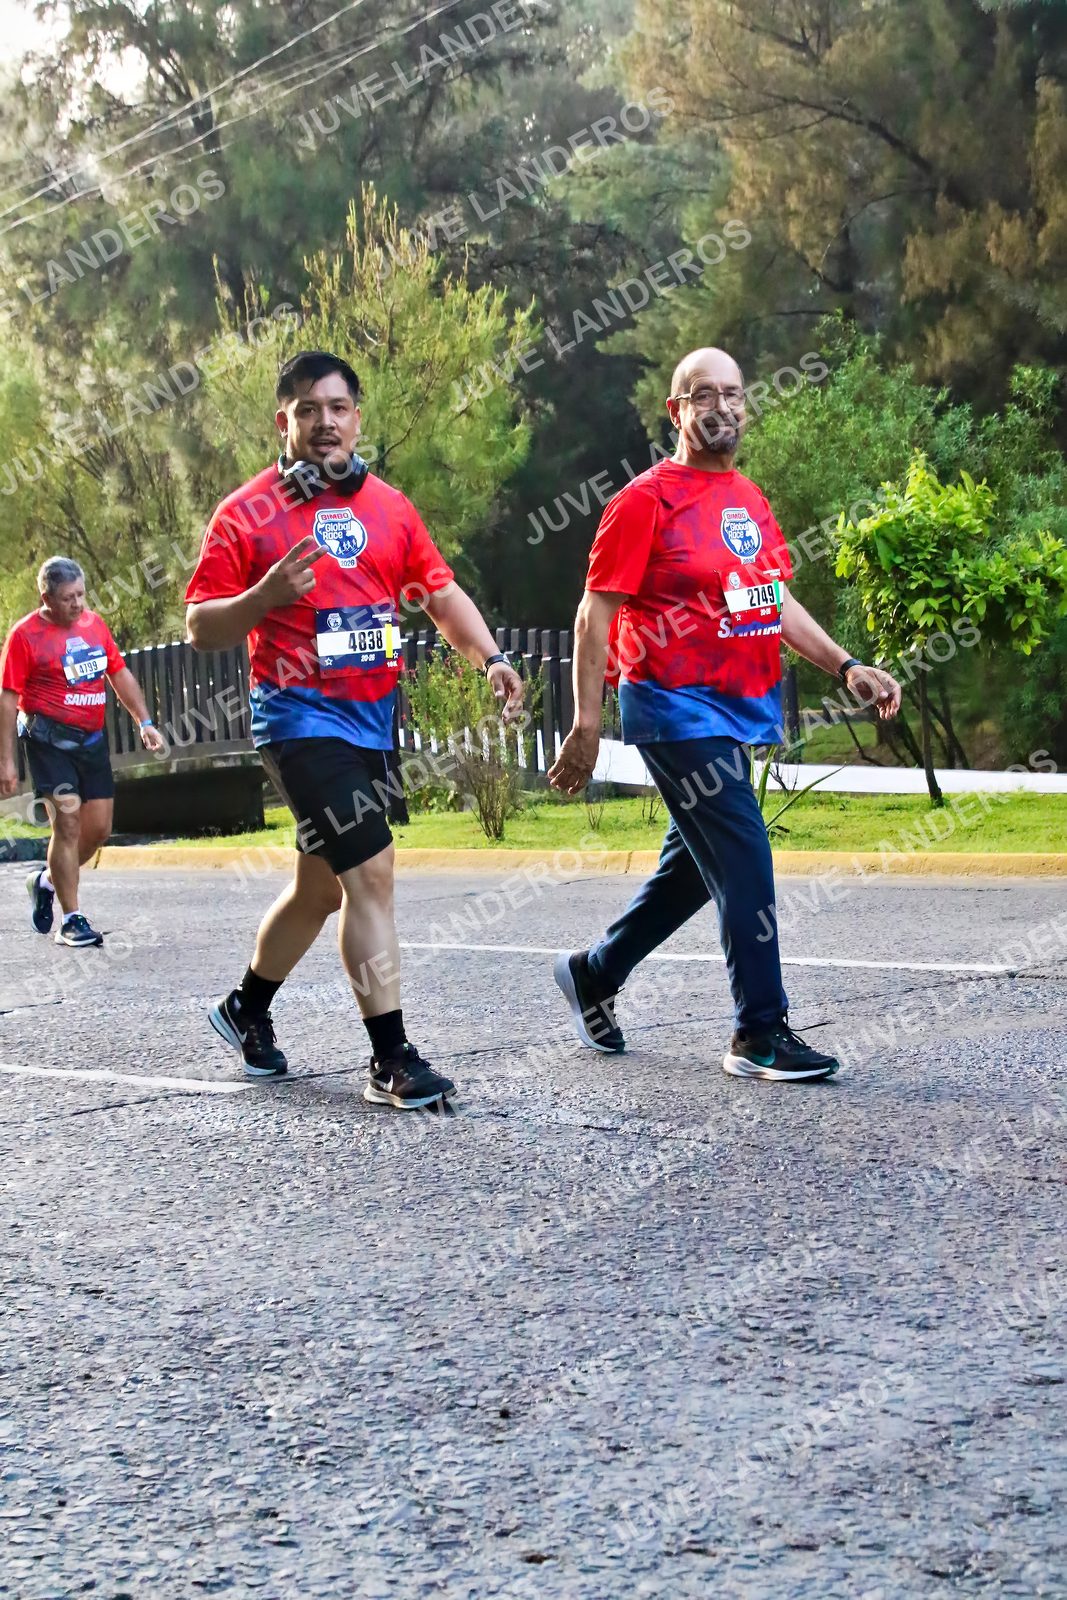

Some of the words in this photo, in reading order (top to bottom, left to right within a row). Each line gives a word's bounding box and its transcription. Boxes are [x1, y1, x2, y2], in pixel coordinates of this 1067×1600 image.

[325, 522, 351, 532] Global
[323, 531, 343, 540] Race
[747, 585, 775, 607] 2749
[348, 630, 383, 652] 4838
[80, 661, 98, 674] 4799
